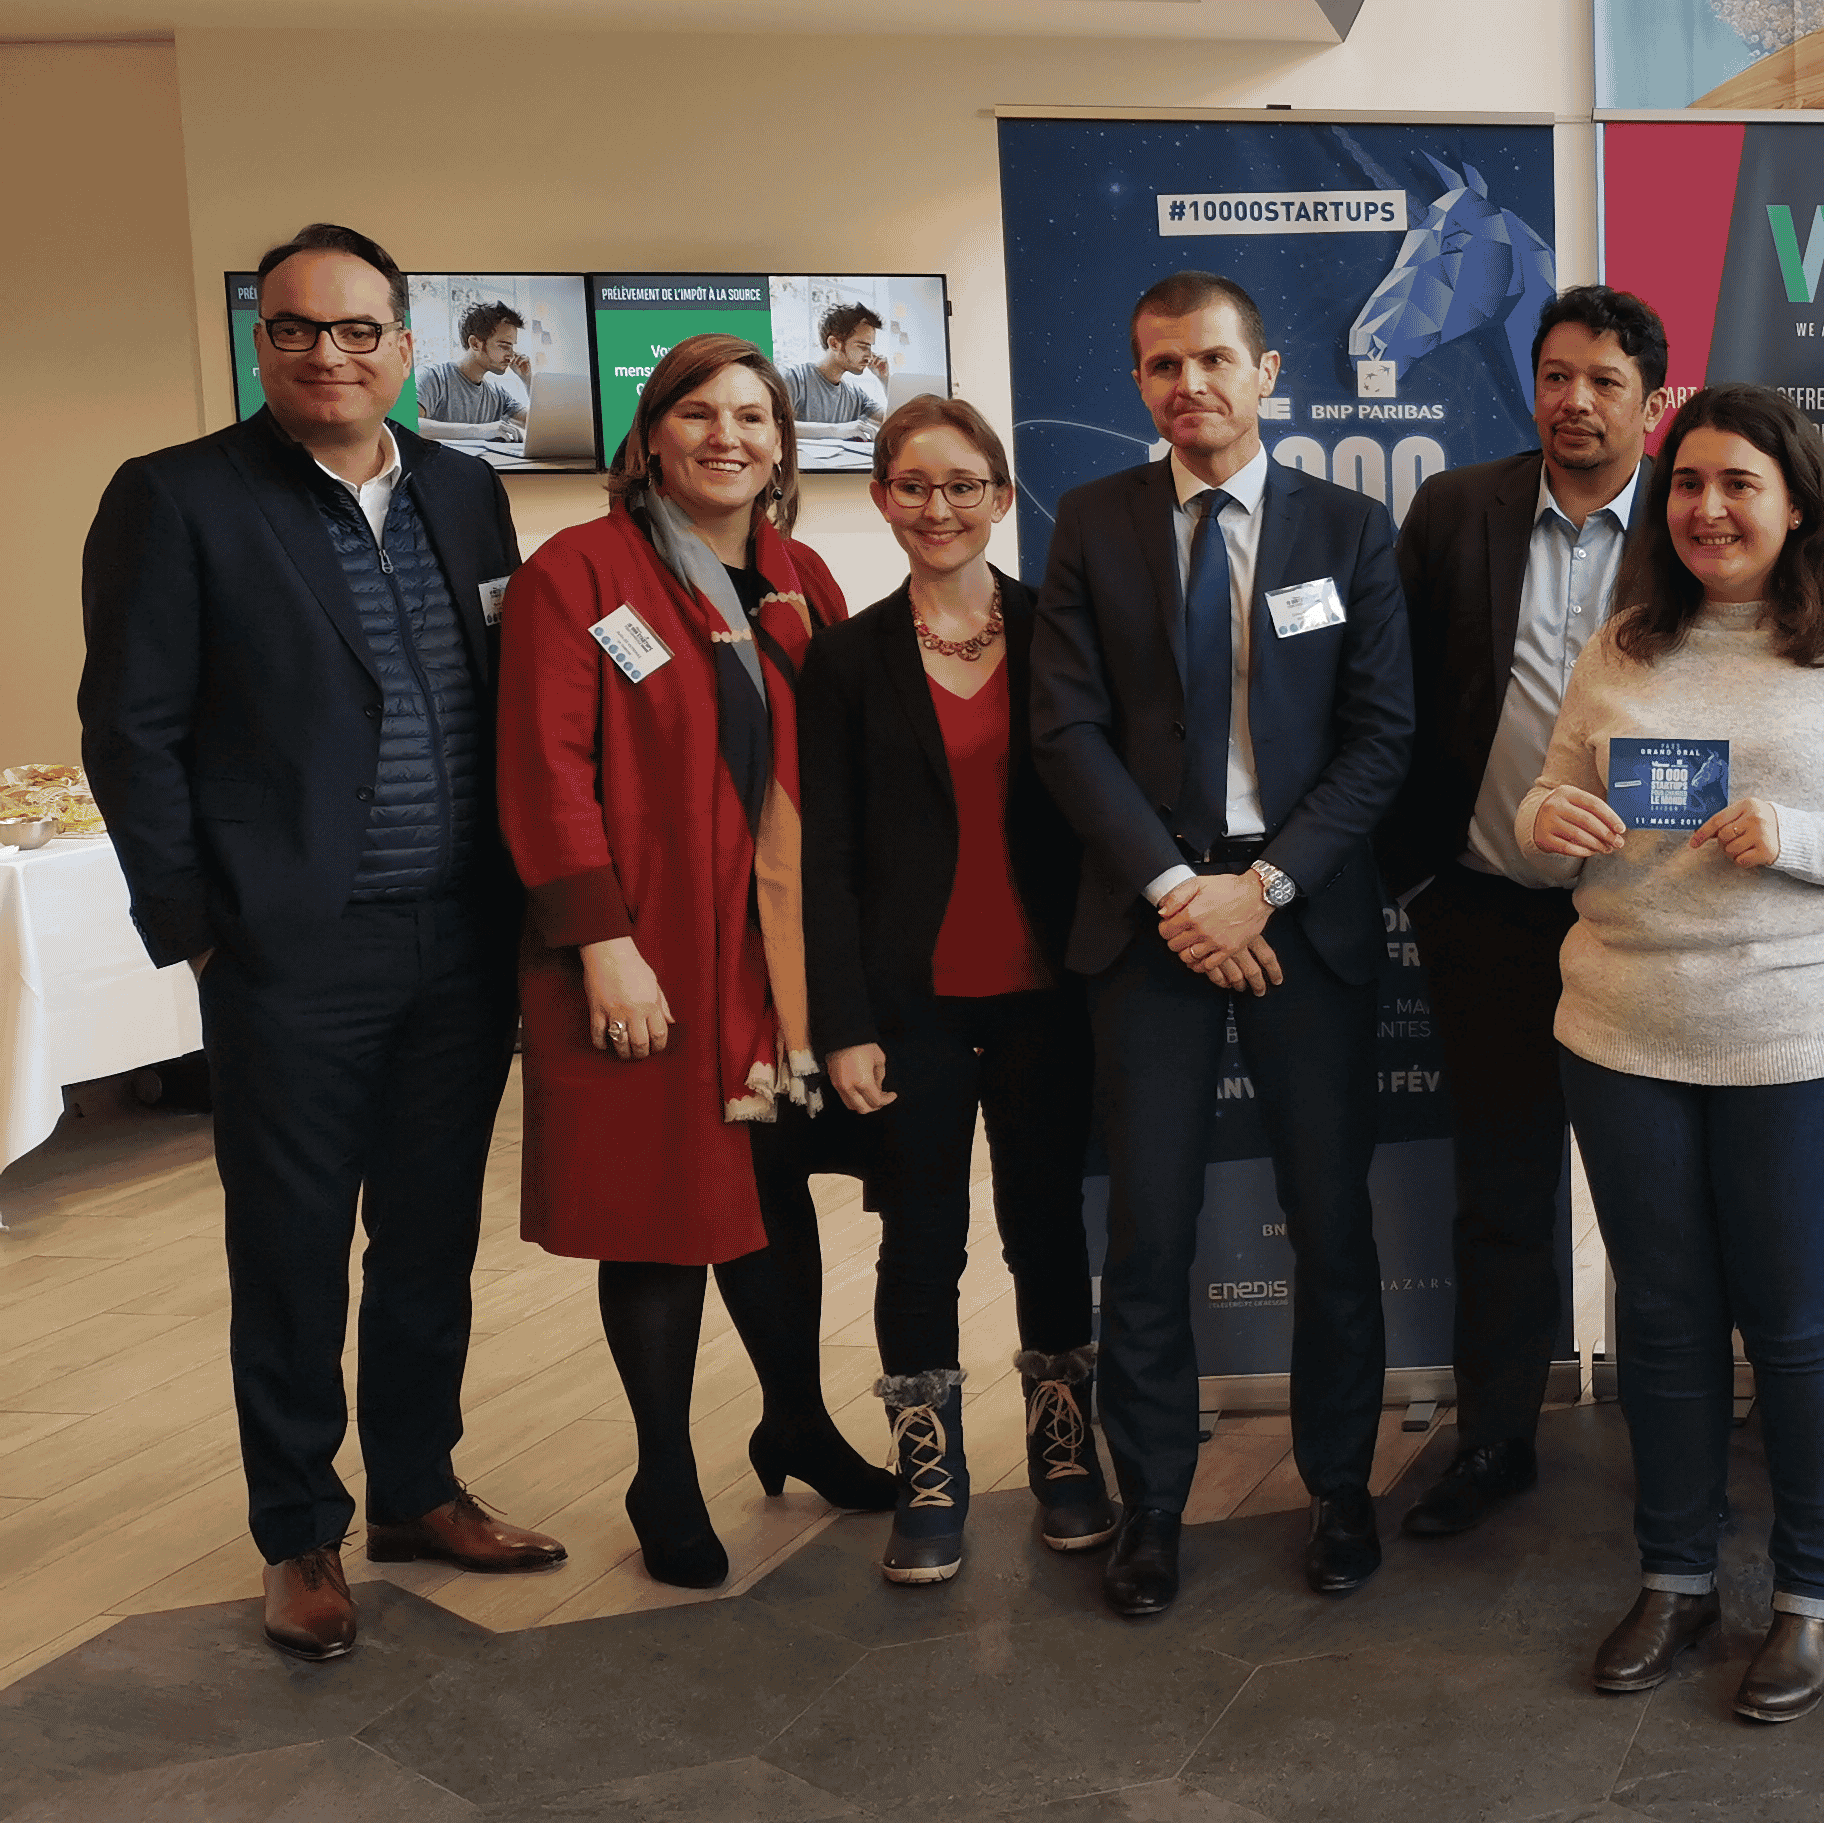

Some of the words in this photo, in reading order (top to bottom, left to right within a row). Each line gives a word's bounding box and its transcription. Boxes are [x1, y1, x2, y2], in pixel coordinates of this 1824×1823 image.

[1168, 200, 1396, 222] #10000STARTUPS
[601, 285, 660, 301] PRÉLÈVEMENT
[661, 288, 673, 301] DE
[674, 286, 707, 301] L'IMPÔT
[708, 283, 716, 301] À
[716, 288, 728, 301] LA
[728, 288, 762, 301] SOURCE
[1795, 322, 1815, 338] WE
[614, 366, 656, 378] mens
[1311, 404, 1353, 420] BNP
[1358, 404, 1445, 420] PARIBAS
[1640, 748, 1672, 756] GRAND
[1676, 749, 1701, 757] ORAL
[1651, 767, 1664, 782] 10
[1665, 768, 1689, 782] 000
[1650, 817, 1676, 825] MARS
[1377, 1020, 1432, 1038] NTES
